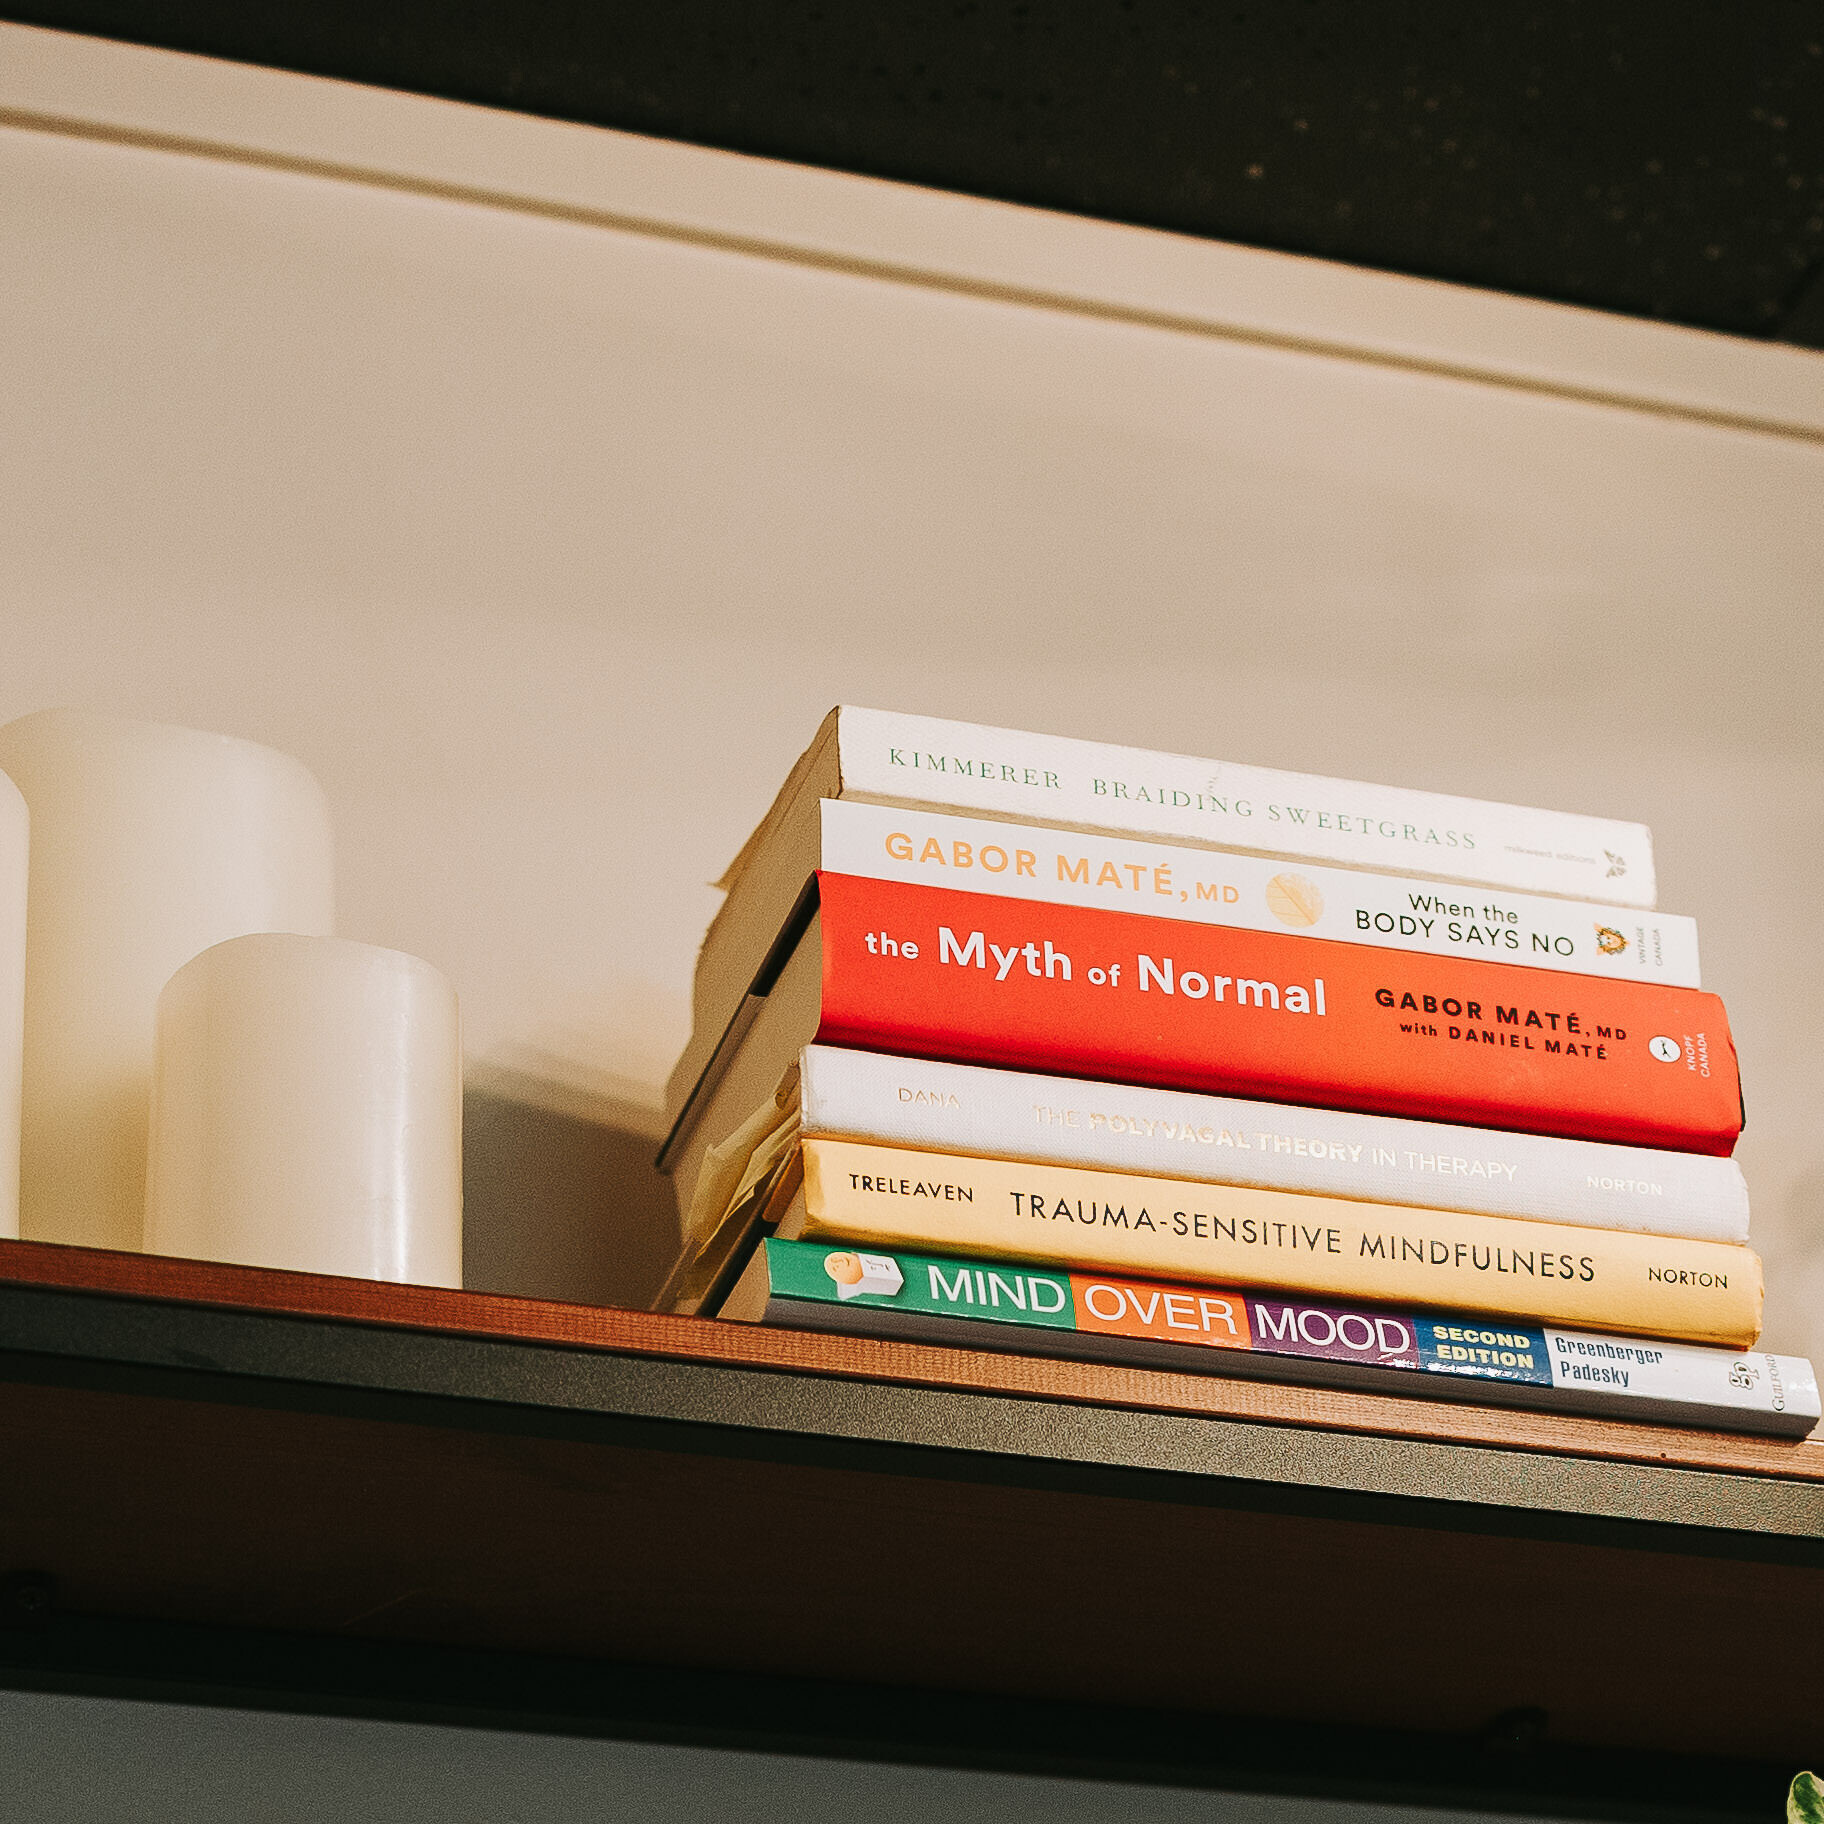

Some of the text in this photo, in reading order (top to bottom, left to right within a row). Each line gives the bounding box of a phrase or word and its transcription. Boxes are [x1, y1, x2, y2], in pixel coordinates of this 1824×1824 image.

[889, 748, 1477, 850] KIMMERER BRAIDING SWEETGRASS
[884, 832, 1240, 904] GABOR MATÉ, MD
[1504, 845, 1597, 865] milkweed editions
[1408, 893, 1519, 925] When the
[1355, 909, 1575, 957] BODY SAYS NO
[1635, 926, 1647, 965] VINTAGE
[1652, 928, 1664, 967] CANADA
[864, 926, 1327, 1017] the Myth of Normal
[1374, 988, 1628, 1041] GABOR MATÉ, MD
[1399, 1020, 1609, 1061] with DANIEL MATÉ
[1683, 1034, 1697, 1072] KNOPF
[1696, 1032, 1711, 1079] CANADA
[897, 1086, 962, 1110] DANA
[1032, 1105, 1519, 1184] THE POLYVAGAL THEORY IN THERAPY
[848, 1173, 975, 1203] TRELEAVEN
[1586, 1174, 1664, 1197] NORTON
[1010, 1191, 1596, 1284] TRAUMA-SENSITIVE MINDFULNESS
[1647, 1266, 1730, 1291] NORTON
[926, 1264, 1412, 1356] MIND OVER MOOD
[1431, 1324, 1532, 1350] SECOND
[1554, 1335, 1665, 1367] Greenberger
[1436, 1344, 1535, 1370] EDITION
[1559, 1360, 1631, 1389] Padesky
